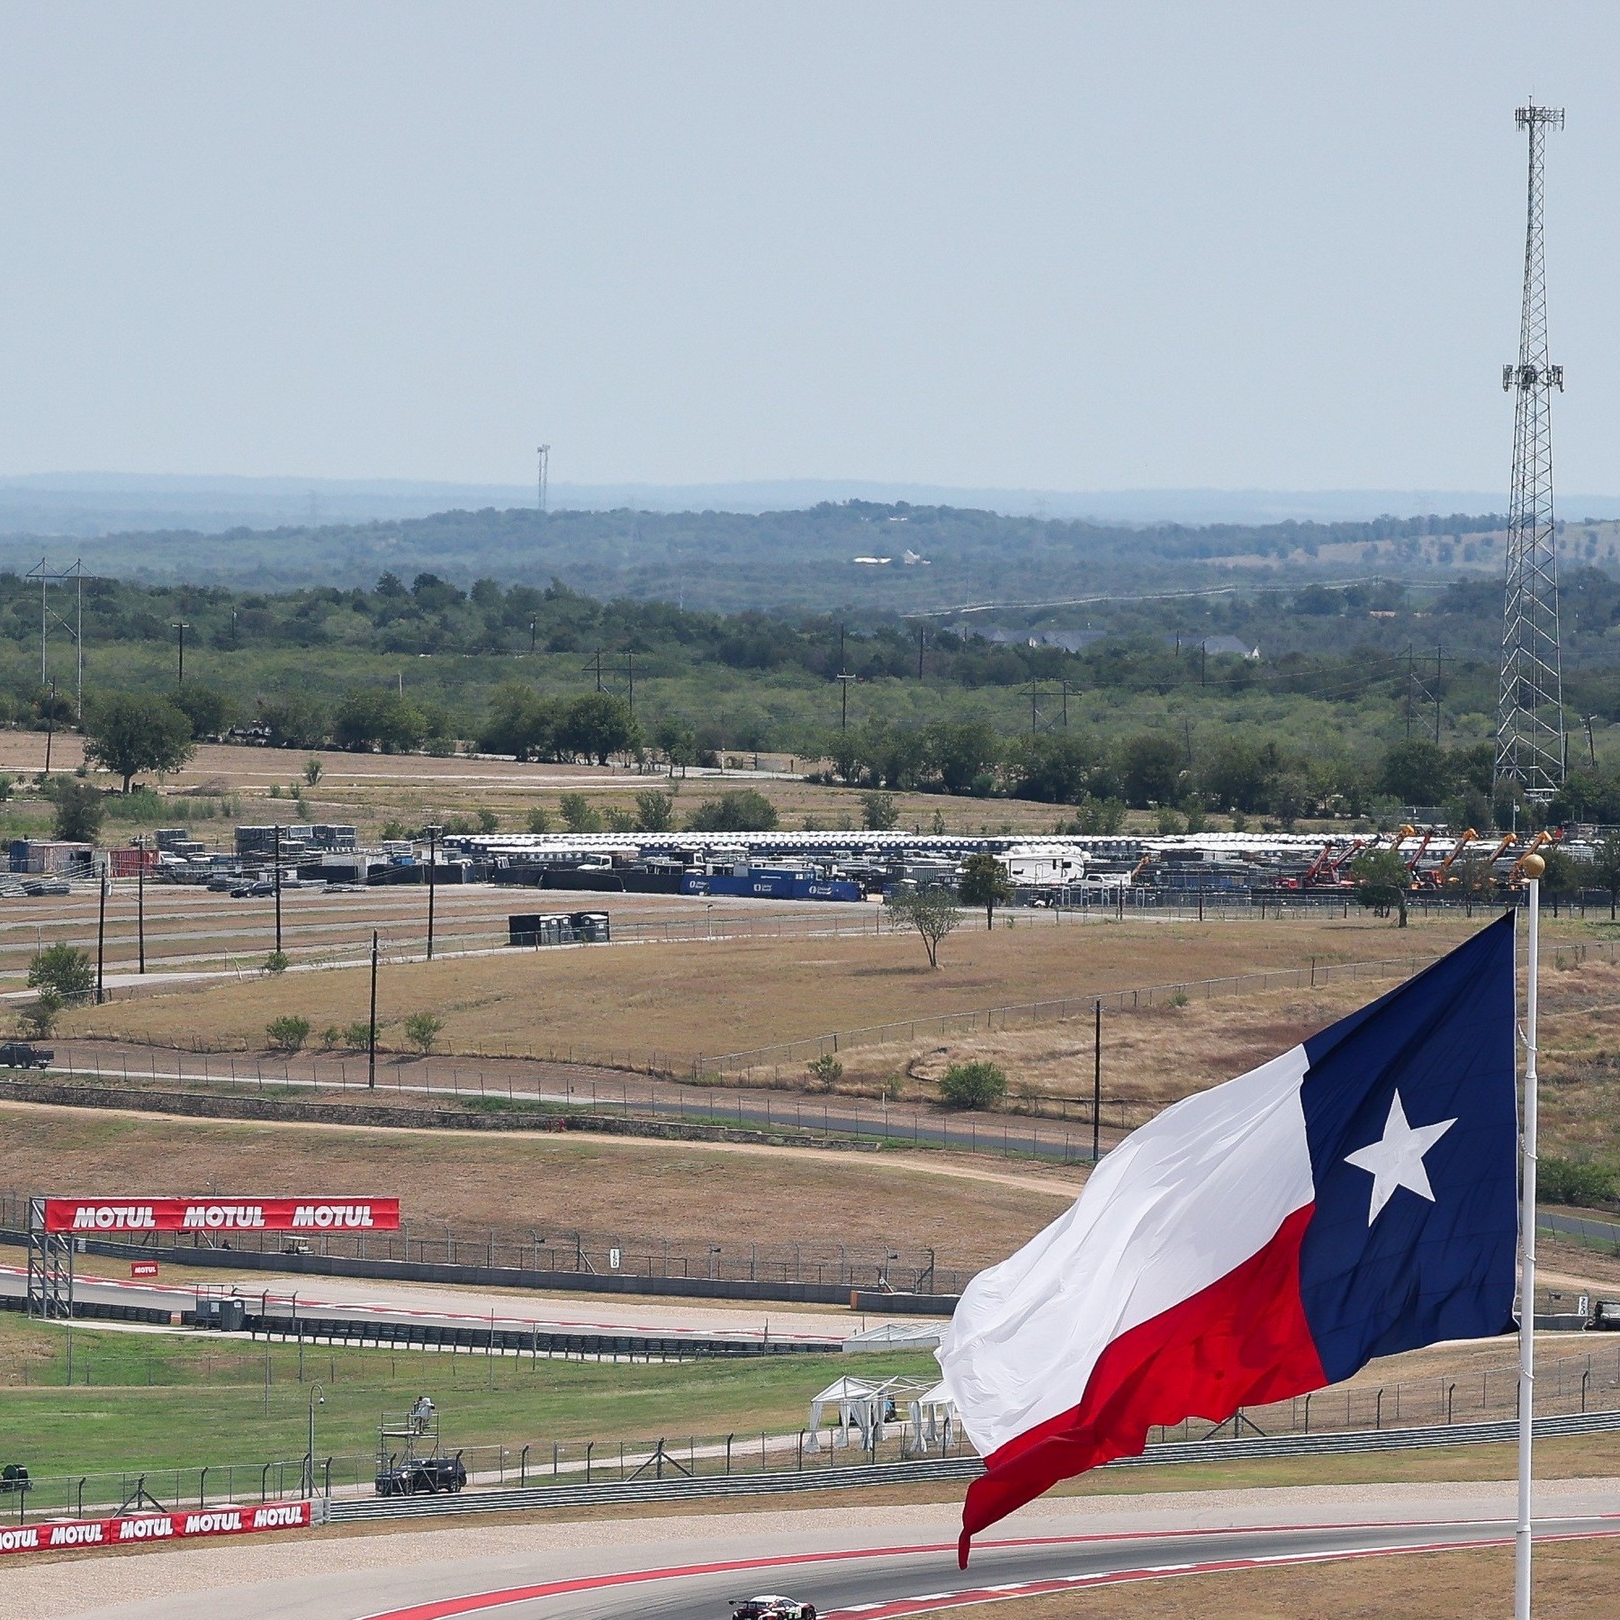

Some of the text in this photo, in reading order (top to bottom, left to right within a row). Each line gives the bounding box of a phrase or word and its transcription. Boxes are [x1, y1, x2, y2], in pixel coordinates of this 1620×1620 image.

[73, 1205, 374, 1228] MOTUL MOTUL MOTUL
[49, 1524, 103, 1545] MOTUL
[119, 1518, 174, 1539] MOTUL
[184, 1512, 242, 1533] MOTUL
[253, 1506, 303, 1528] MOTUL
